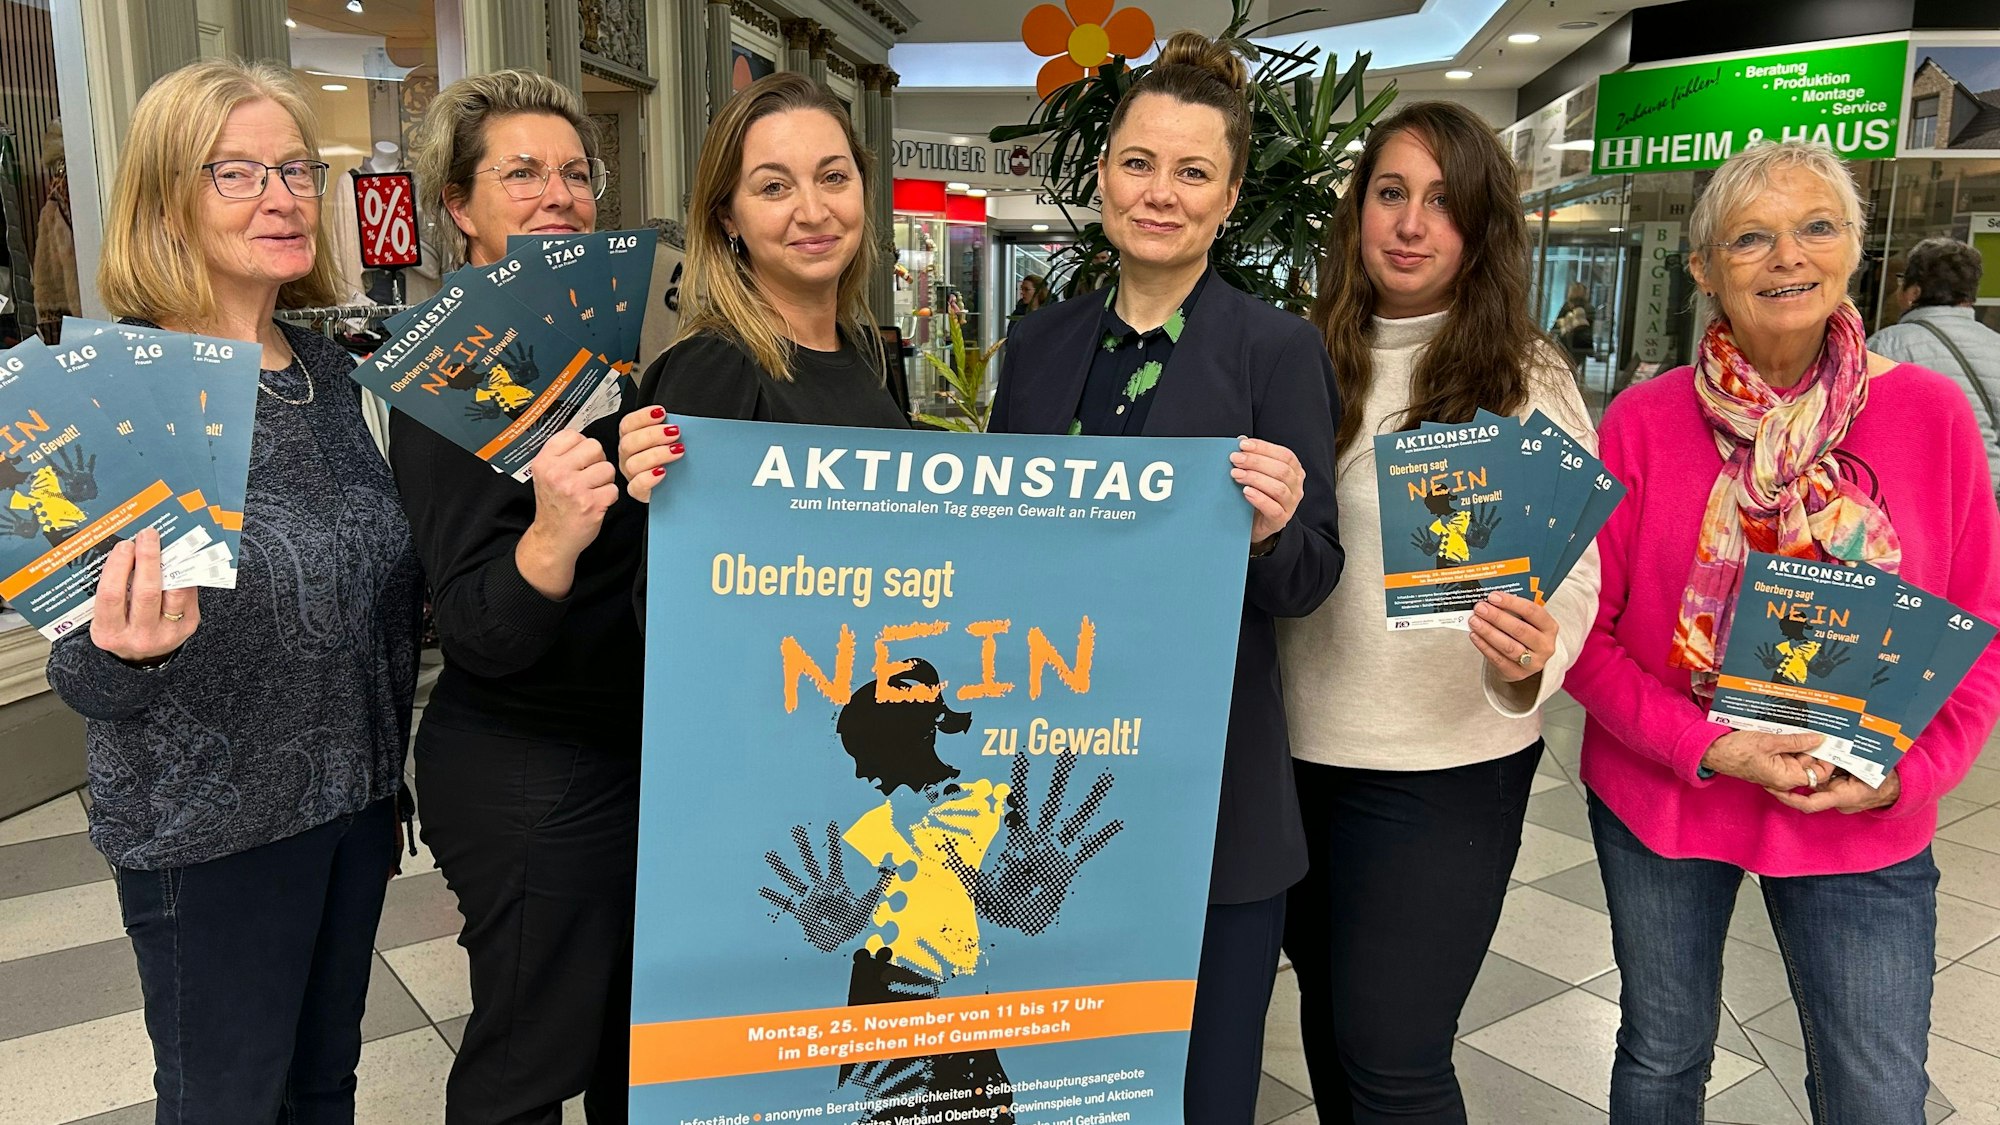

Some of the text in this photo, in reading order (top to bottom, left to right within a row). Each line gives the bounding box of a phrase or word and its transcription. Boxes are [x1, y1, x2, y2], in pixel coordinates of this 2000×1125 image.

[1745, 61, 1808, 77] Beratung
[1773, 73, 1850, 90] Produktion
[1615, 66, 1721, 131] Zuhause fühlen!
[1802, 86, 1865, 103] Montage
[1831, 100, 1887, 116] Service
[1646, 130, 1733, 165] HEIM
[375, 286, 464, 372] AKTIONSTAG
[481, 327, 519, 366] zu Gewalt!
[127, 344, 164, 360] AG
[390, 345, 444, 393] Oberberg sagt
[420, 324, 494, 396] NEIN
[27, 424, 81, 464] zu Gewalt!
[1395, 424, 1500, 450] AKTIONSTAG
[752, 445, 1174, 501] AKTIONSTAG
[1389, 458, 1448, 476] Oberberg sagt
[1407, 466, 1487, 501] NEIN
[790, 497, 1136, 520] zum Internationalen Tag gegen Gewalt an Frauen
[1460, 489, 1502, 506] zu Gewalt!
[711, 553, 955, 609] Oberberg sagt
[1767, 559, 1876, 586] AKTIONSTAG
[1754, 581, 1814, 601] Oberberg sagt
[1766, 600, 1850, 627] NEIN
[1814, 629, 1860, 644] zu Gewalt!
[780, 615, 1096, 713] NEIN
[981, 717, 1140, 757] zu Gewalt!
[748, 997, 1105, 1042] Montag, 25. November von 11 bis 17 Uhr
[778, 1019, 1071, 1060] im Bergischen Hof Gummersbach
[764, 1106, 823, 1122] anonyme
[826, 1088, 972, 1115] Beratungsmöglichkeiten
[985, 1068, 1145, 1095] Selbstbehauptungsangebote
[894, 1111, 943, 1125] Verband
[944, 1105, 999, 1121] Oberberg
[1009, 1095, 1082, 1114] Gewinnspiele
[1085, 1091, 1104, 1104] und
[1106, 1087, 1154, 1102] Aktionen
[1075, 1111, 1130, 1125] Getränken
